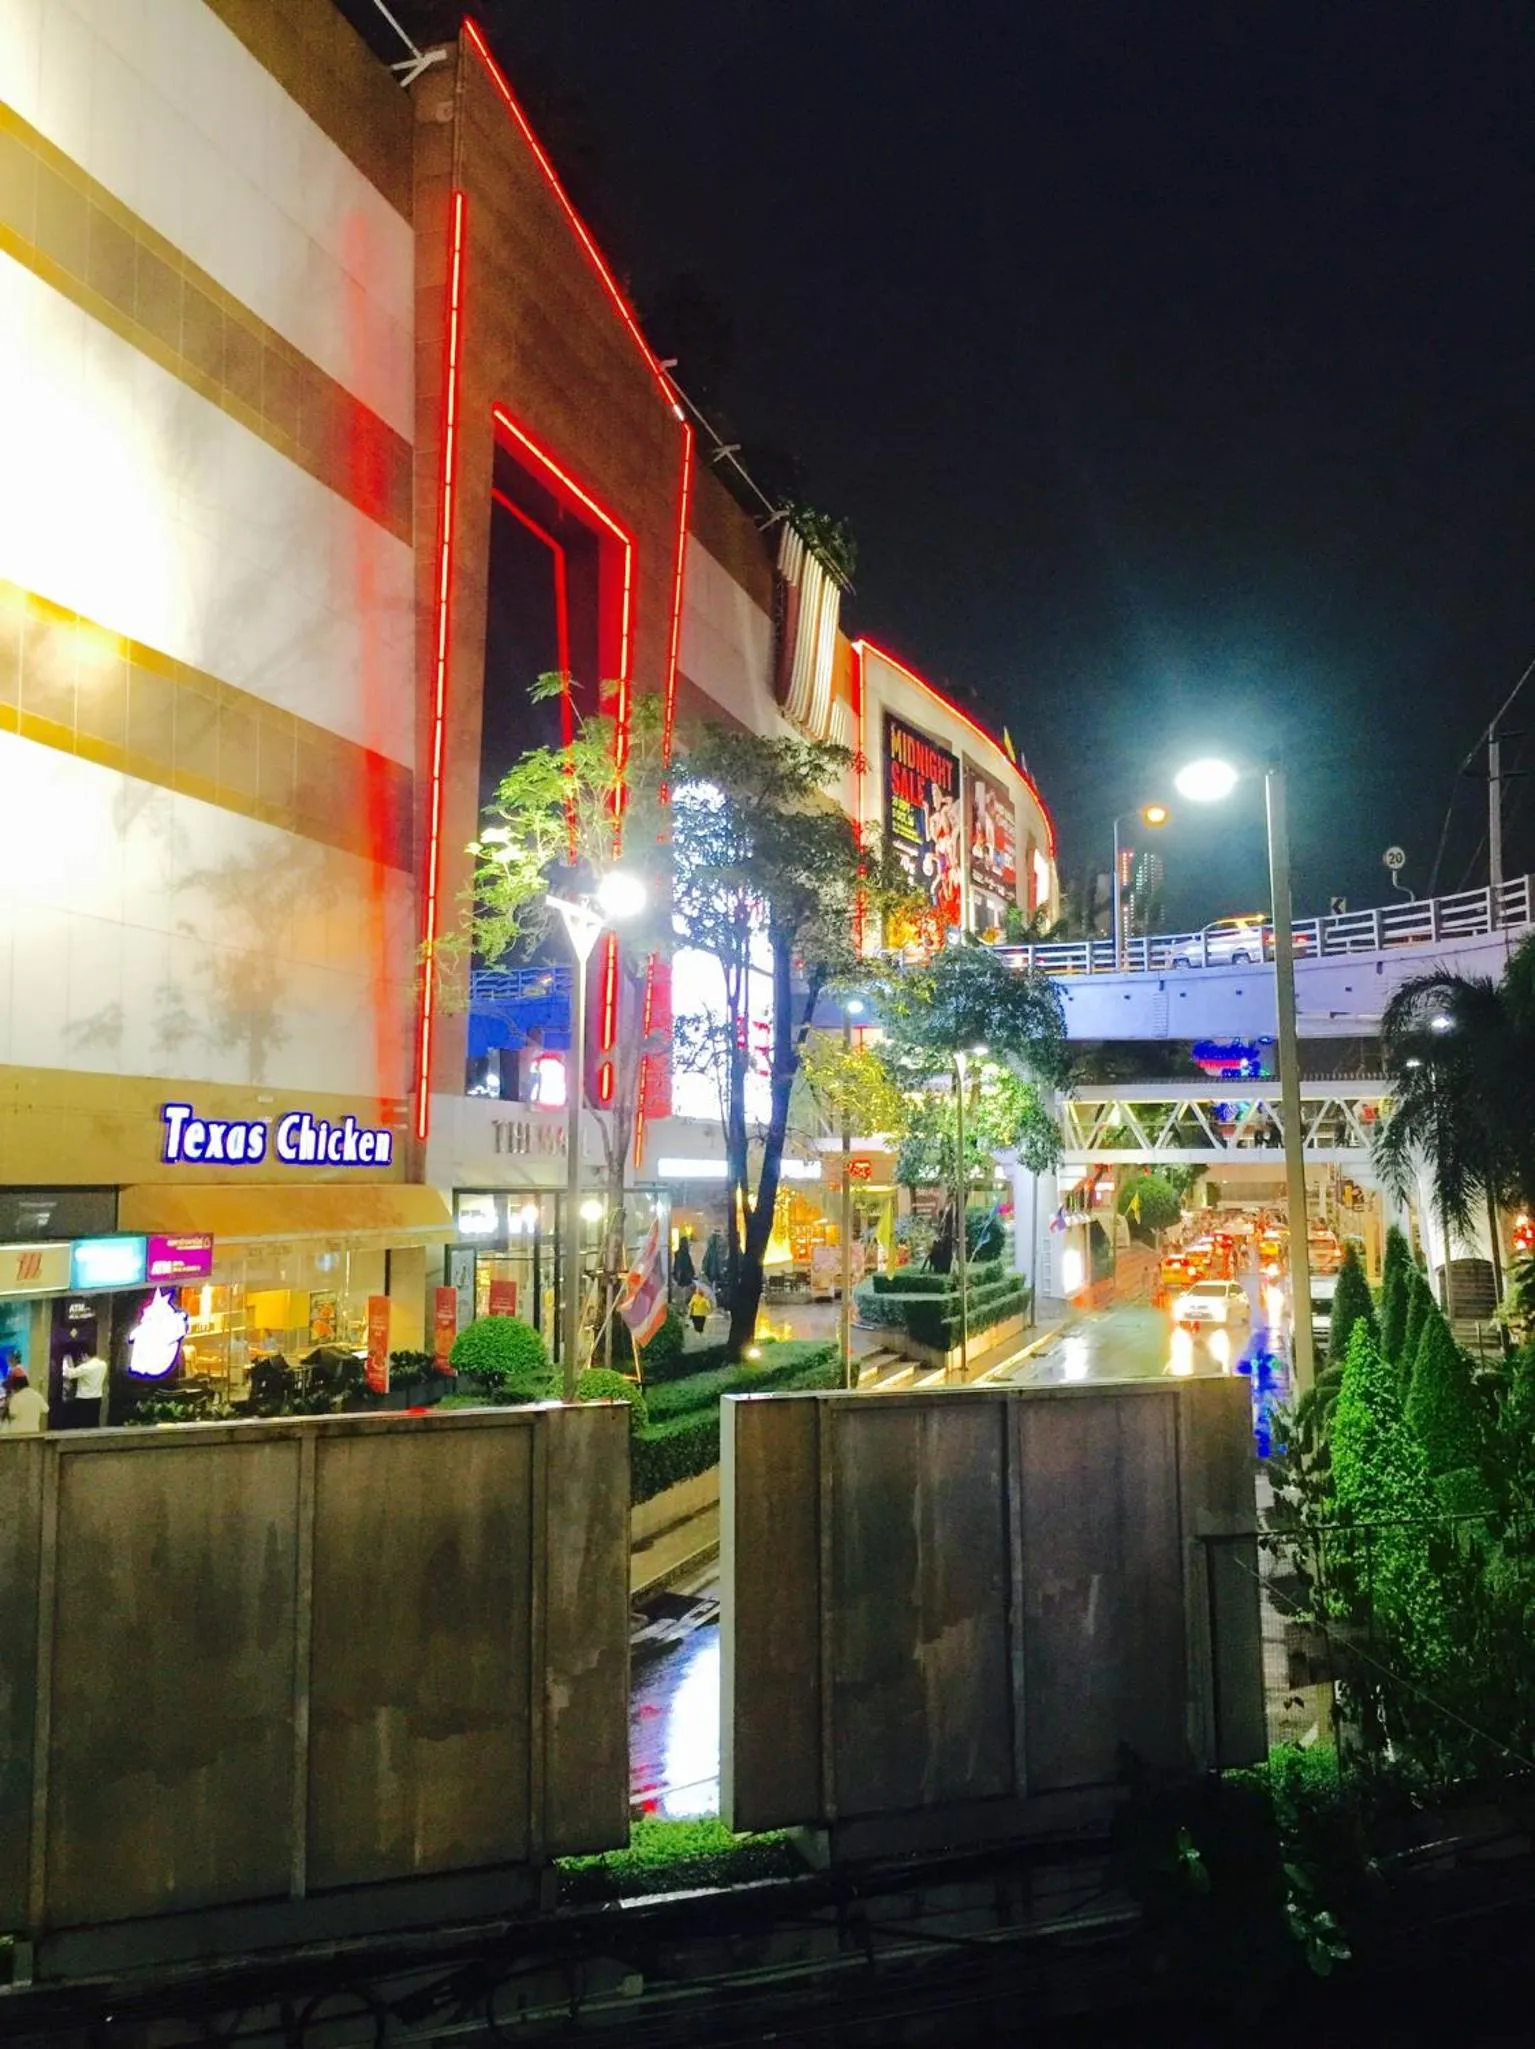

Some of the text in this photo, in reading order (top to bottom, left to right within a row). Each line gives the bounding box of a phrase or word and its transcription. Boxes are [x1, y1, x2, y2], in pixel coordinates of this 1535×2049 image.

[891, 724, 953, 792] MIDNIGHT
[891, 760, 925, 809] SALE
[1388, 852, 1403, 865] 20
[164, 1104, 393, 1163] Texas Chicken
